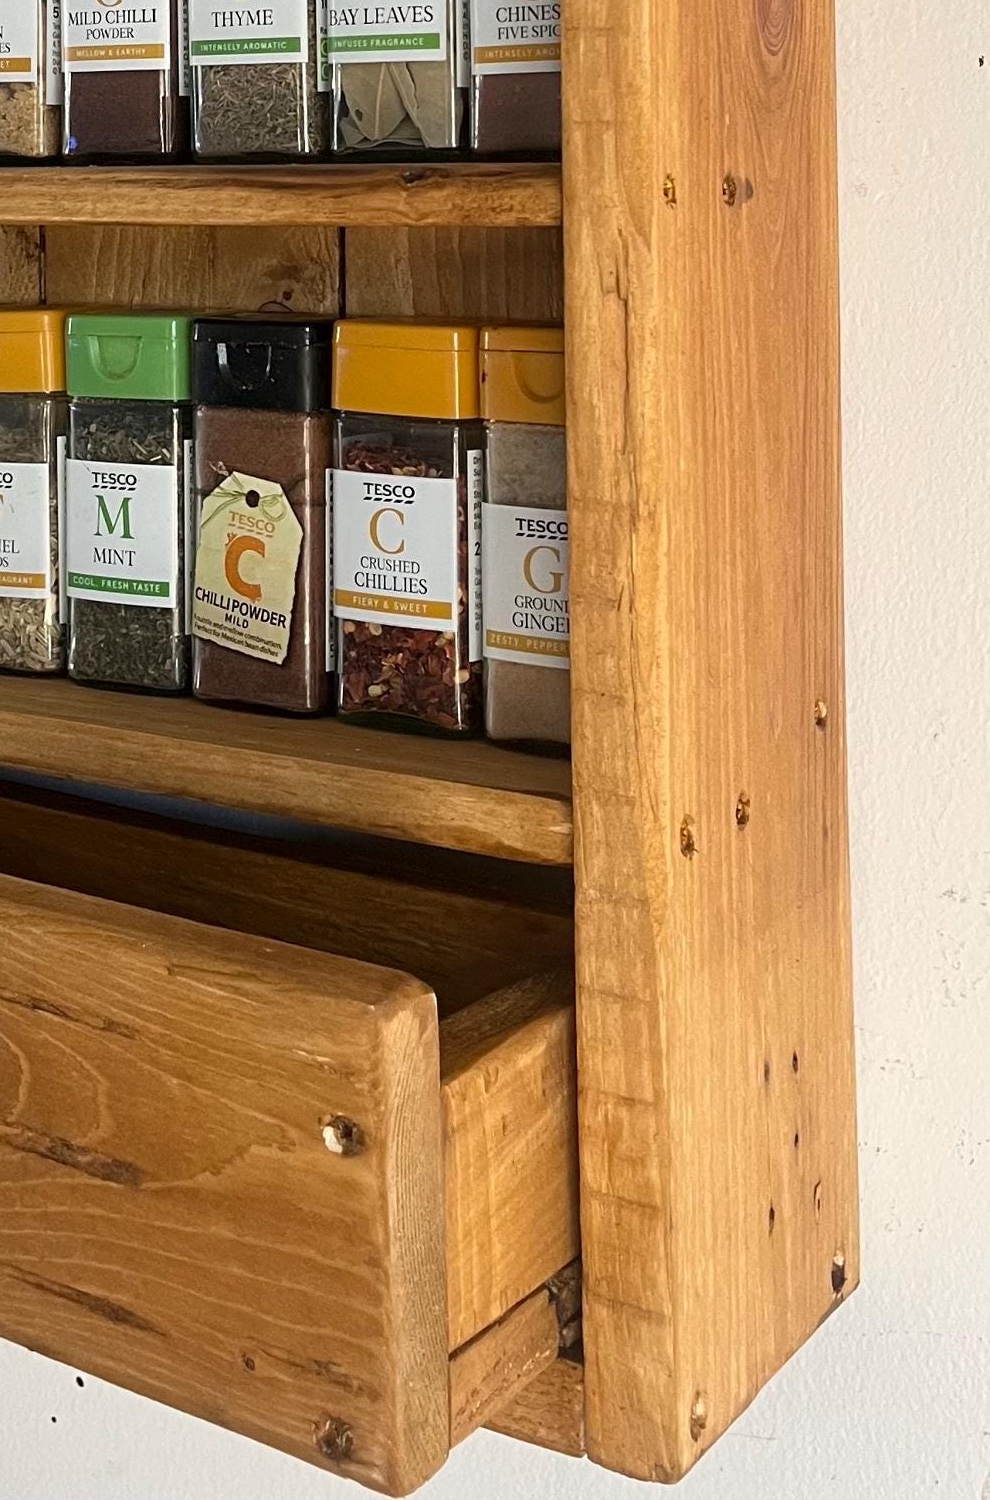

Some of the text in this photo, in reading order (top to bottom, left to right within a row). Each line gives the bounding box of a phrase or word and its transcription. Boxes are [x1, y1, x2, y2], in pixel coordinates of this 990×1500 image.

[68, 8, 157, 26] MILD CHILLI
[211, 9, 274, 28] THYME
[329, 5, 434, 26] BAY LEAVES
[495, 4, 561, 23] CHINES
[86, 27, 135, 40] POWDER
[497, 24, 561, 40] FIVE SPIC
[201, 41, 287, 51] INTENSELY AROMATIC
[334, 37, 425, 48] INFUSES FRAGRANCE
[76, 48, 146, 57] MELLOW EARTHY
[485, 48, 533, 58] INTENSELY
[92, 471, 137, 486] TESCO
[363, 482, 416, 498] TESCO
[94, 494, 135, 540] M
[229, 510, 276, 534] TESCO
[515, 517, 568, 535] TESCO
[369, 508, 405, 555] C
[93, 547, 136, 567] MINT
[360, 556, 421, 574] CRUSHED
[225, 533, 267, 603] C
[523, 546, 564, 594] G
[101, 578, 129, 590] FRESH
[132, 582, 161, 593] TASTE
[354, 571, 428, 595] CHILLIES
[195, 586, 287, 629] CHILLI POWDER
[353, 596, 428, 614] FIERY SWEET
[514, 594, 569, 613] GROUN
[224, 613, 249, 629] MILD
[512, 611, 570, 633] GINGE
